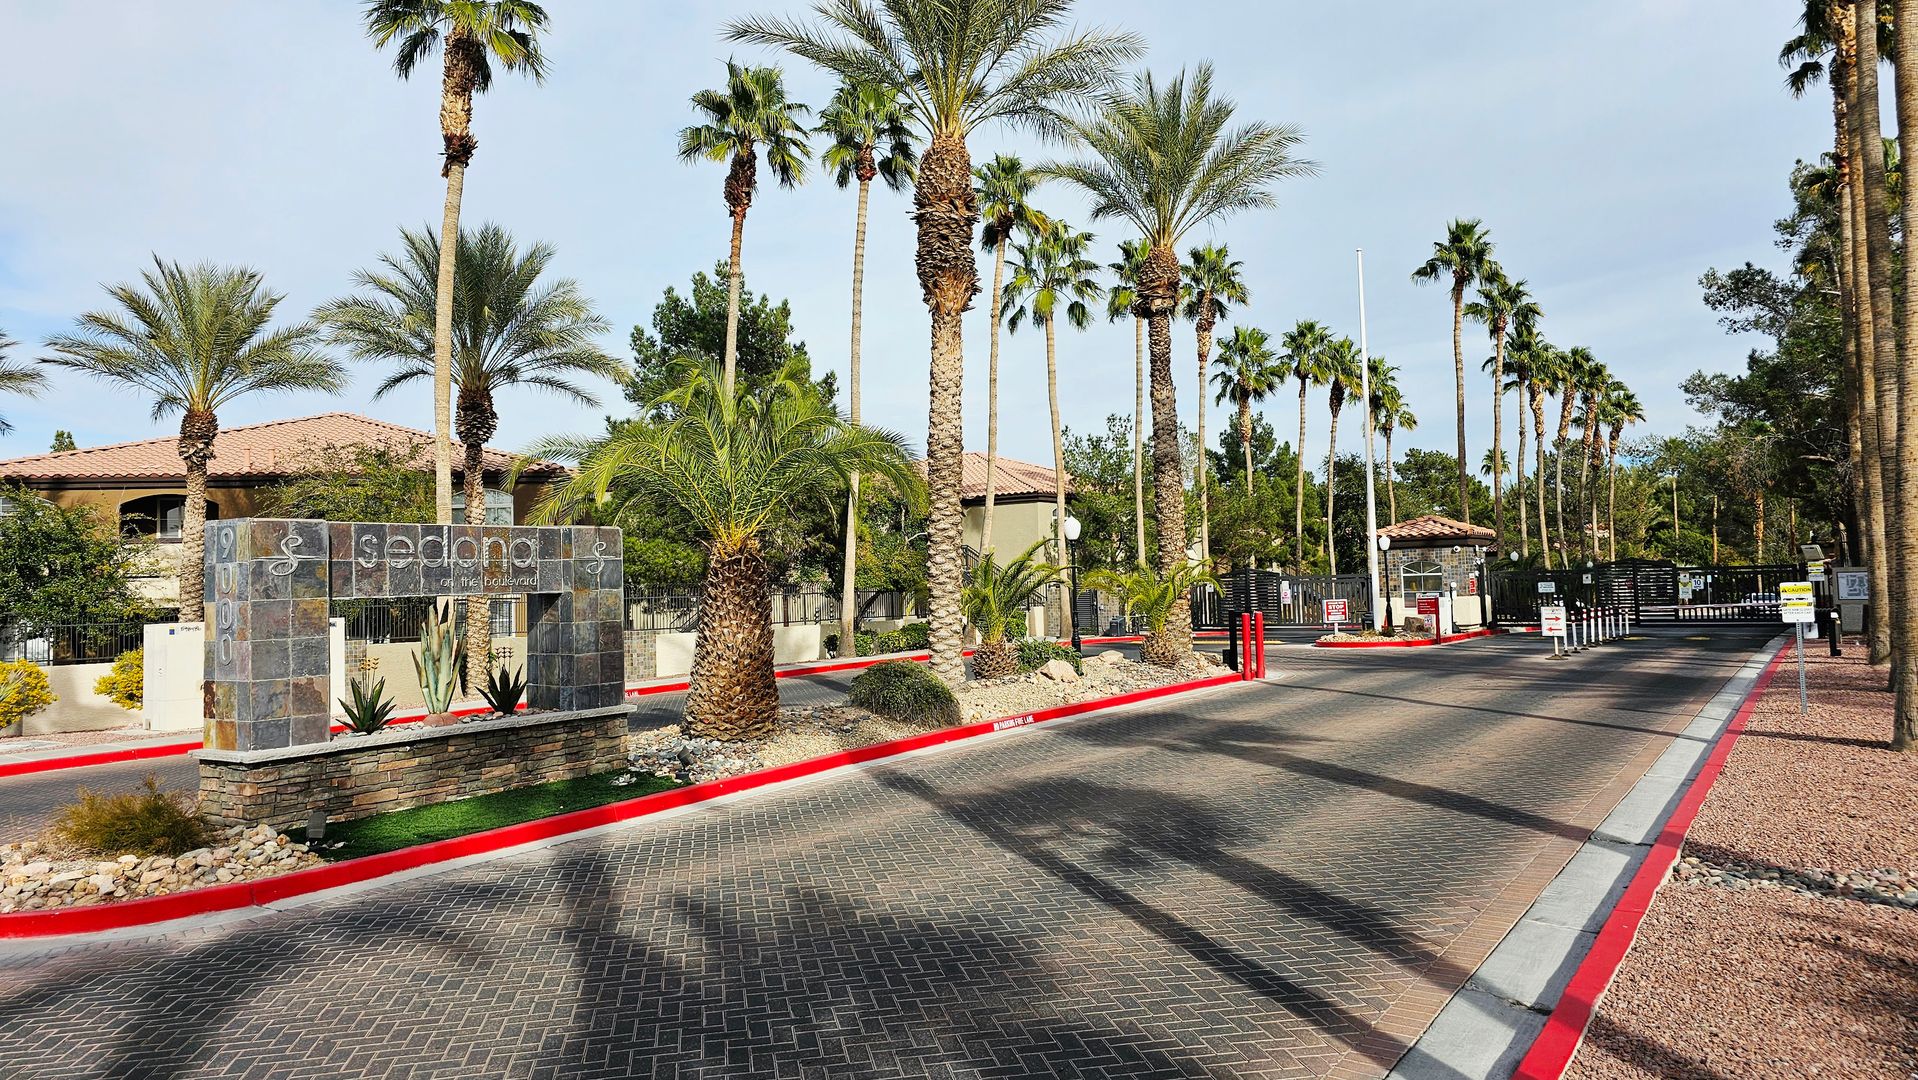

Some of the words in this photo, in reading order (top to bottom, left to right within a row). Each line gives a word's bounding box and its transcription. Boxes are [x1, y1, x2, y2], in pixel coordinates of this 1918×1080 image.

[358, 525, 537, 569] sedona
[440, 579, 454, 587] on
[461, 576, 480, 587] the
[484, 574, 538, 587] boulevard
[220, 527, 234, 666] 9000
[1024, 714, 1035, 723] LANE
